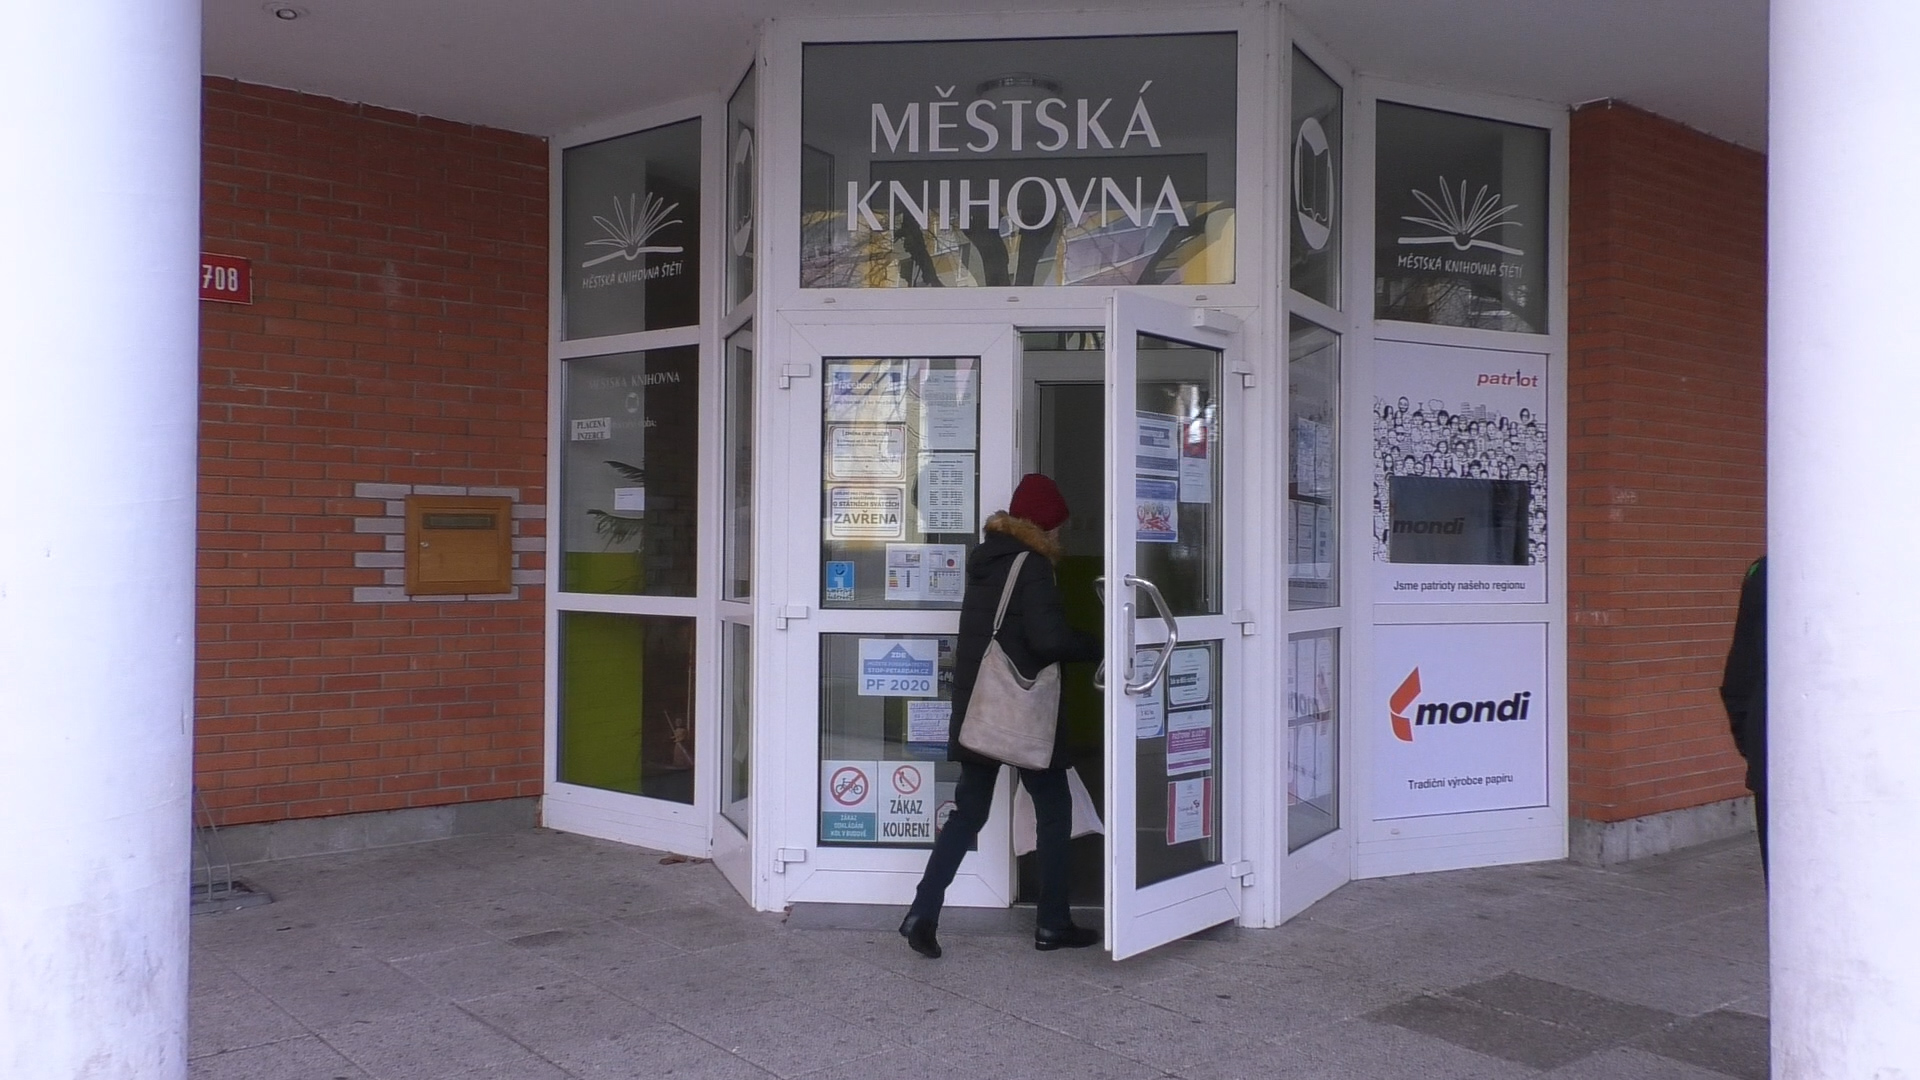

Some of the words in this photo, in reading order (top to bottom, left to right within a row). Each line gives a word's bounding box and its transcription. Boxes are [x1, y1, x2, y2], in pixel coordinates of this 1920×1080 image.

[871, 80, 1162, 154] MĚSTSKÁ
[847, 175, 1190, 232] KNIHOVNA
[1397, 252, 1442, 271] MĚSTSKÁ
[1445, 259, 1497, 276] KNIHOVNA
[1499, 263, 1523, 279] ŠTĚTÍ
[202, 264, 238, 292] 708
[617, 266, 660, 284] KNIHOVNA
[631, 371, 681, 387] KNIHOVNA
[1477, 369, 1539, 388] patriot
[834, 509, 898, 525] ZAVŘENA
[1392, 517, 1466, 535] mondi
[1393, 580, 1419, 591] Jsme
[1420, 580, 1456, 593] patrioty
[1457, 580, 1491, 591] našeho
[1492, 580, 1526, 592] regionu
[890, 651, 907, 659] ZDE
[866, 679, 886, 690] PF
[890, 679, 930, 692] 2020
[1414, 691, 1532, 726] mondi
[1407, 778, 1446, 790] Tradiční
[1447, 774, 1484, 789] výrobce
[1485, 772, 1514, 786] papíru
[890, 795, 923, 815] ZÁKAZ
[839, 813, 858, 821] ZÁKAZ
[882, 818, 930, 838] KOUŘENÍ
